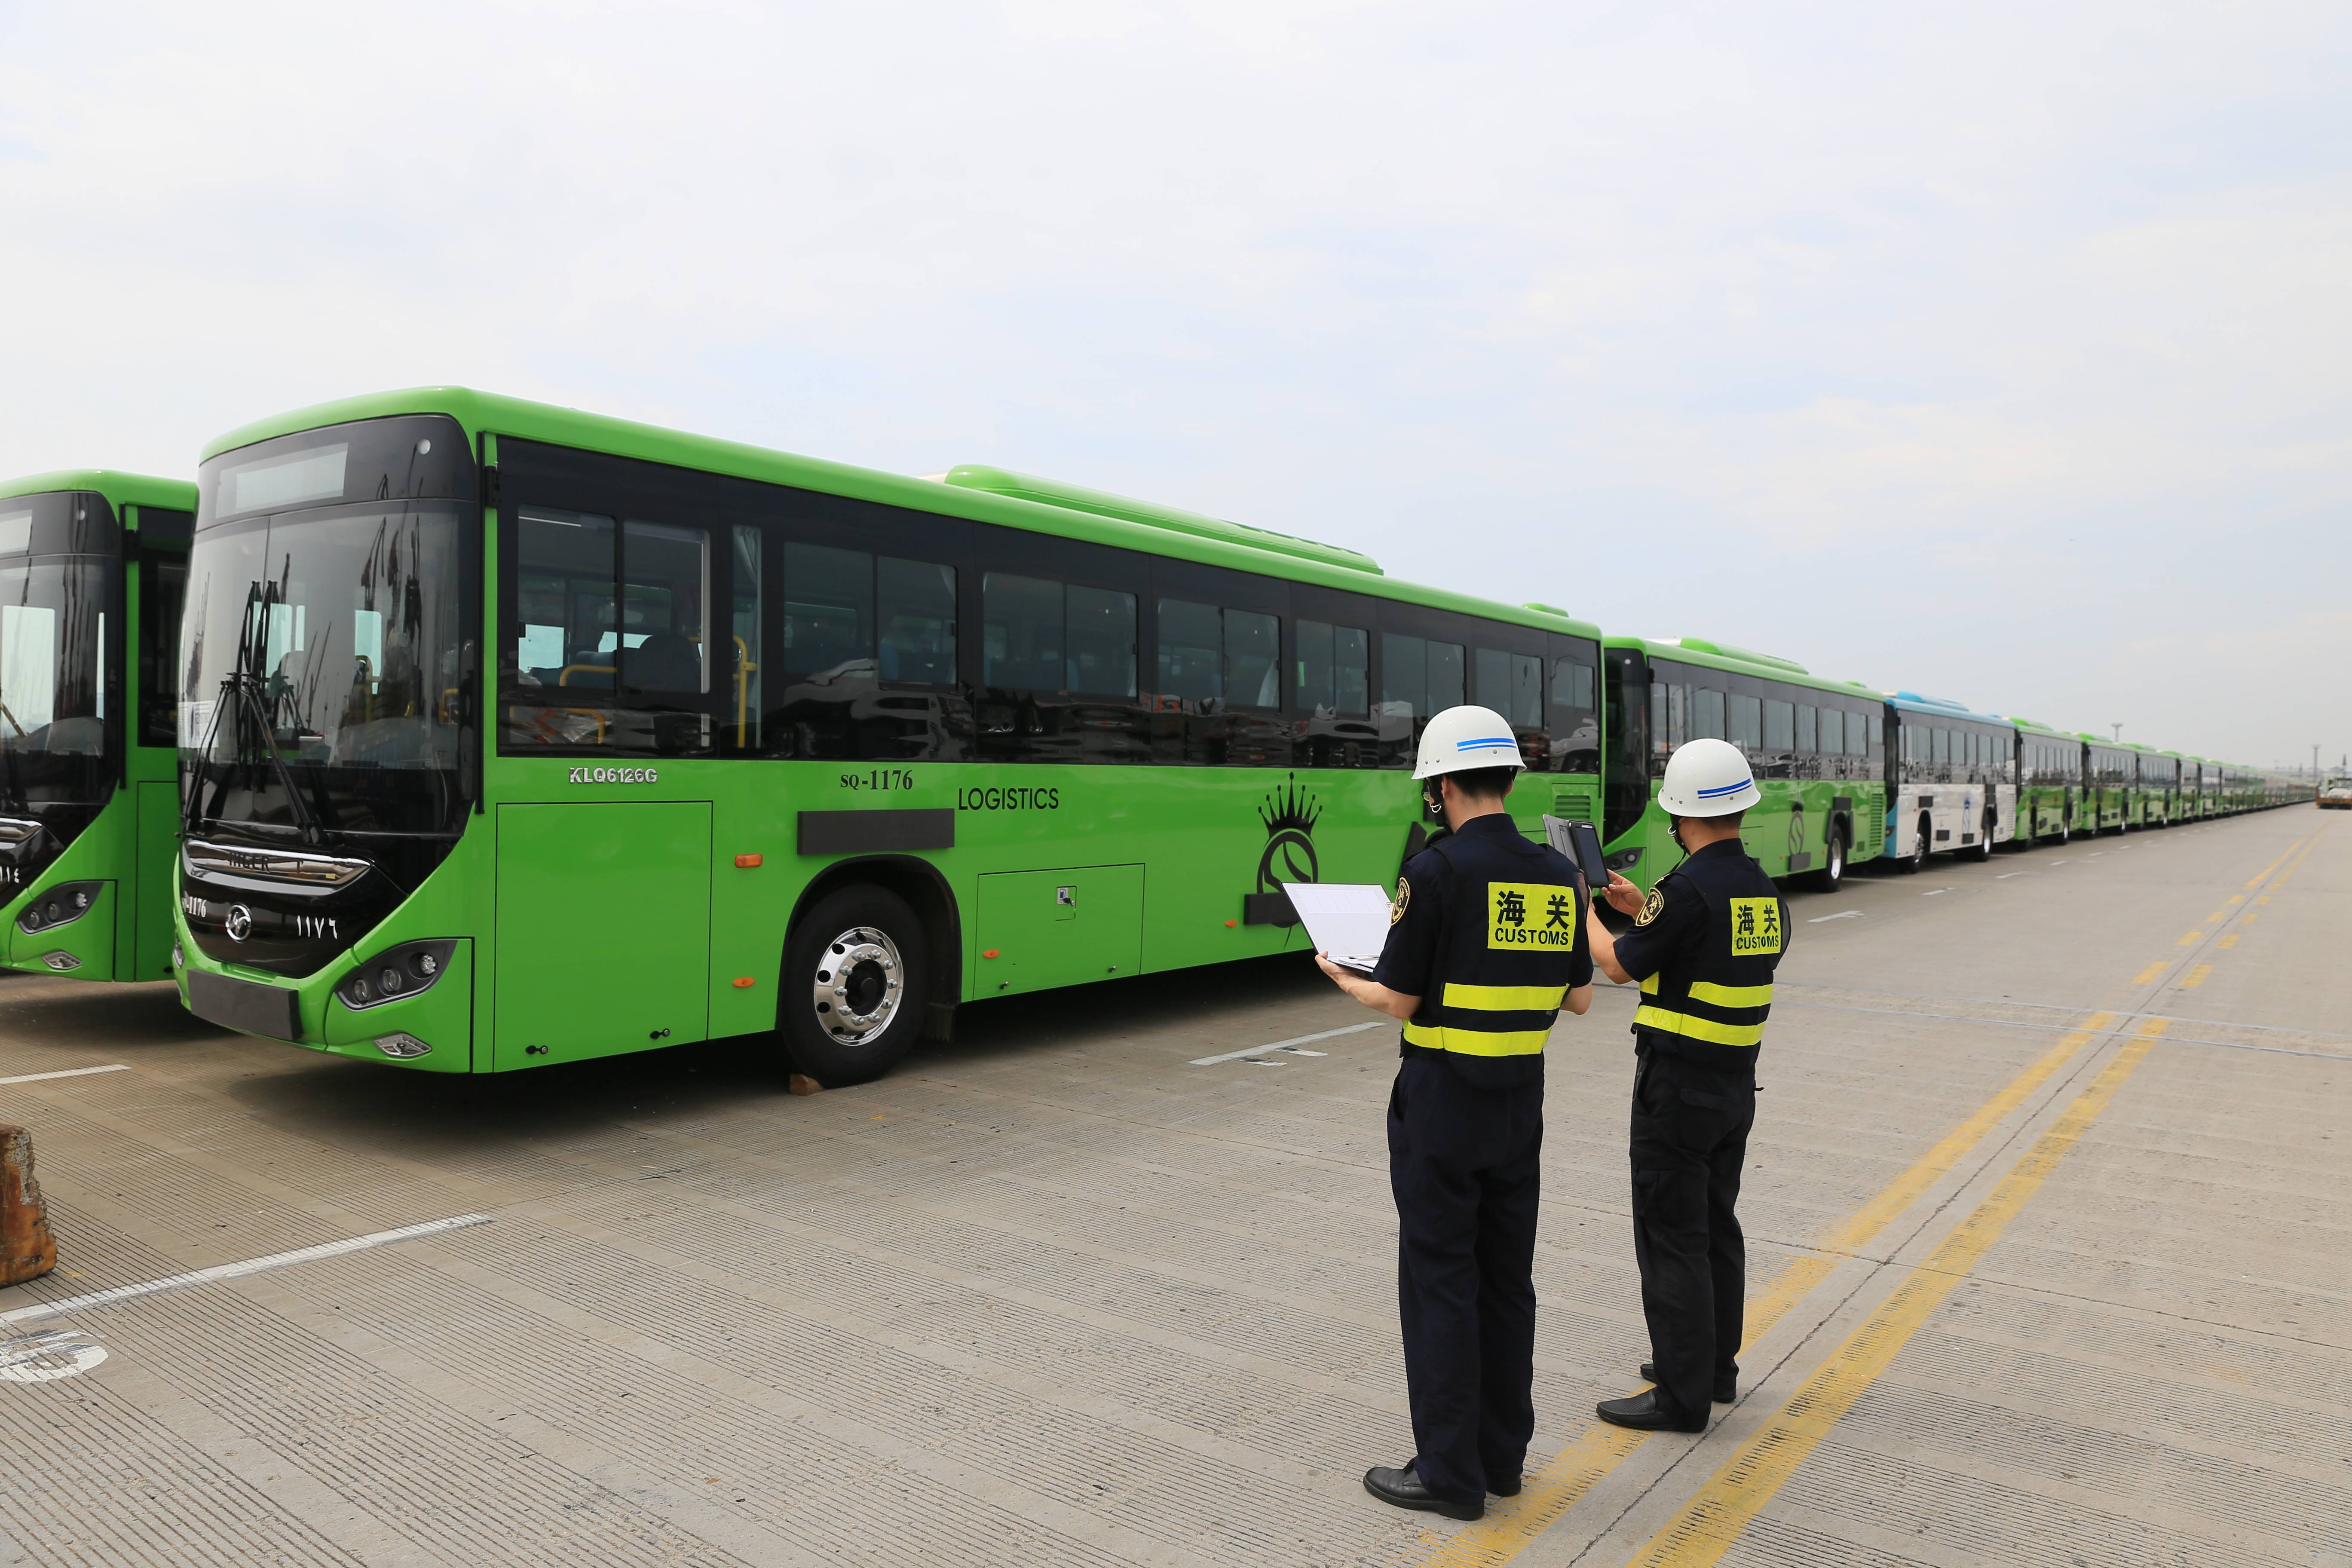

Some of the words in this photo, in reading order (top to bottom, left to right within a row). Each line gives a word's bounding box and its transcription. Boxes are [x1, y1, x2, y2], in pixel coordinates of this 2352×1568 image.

[570, 767, 657, 783] KLQ6126G
[840, 769, 913, 790] SQ-1176
[958, 787, 1059, 810] LOGISTICS
[1496, 890, 1569, 930] 海关
[1737, 904, 1778, 935] 海关
[1495, 928, 1568, 946] CUSTOMS
[1736, 935, 1779, 949] CUSTOMS
